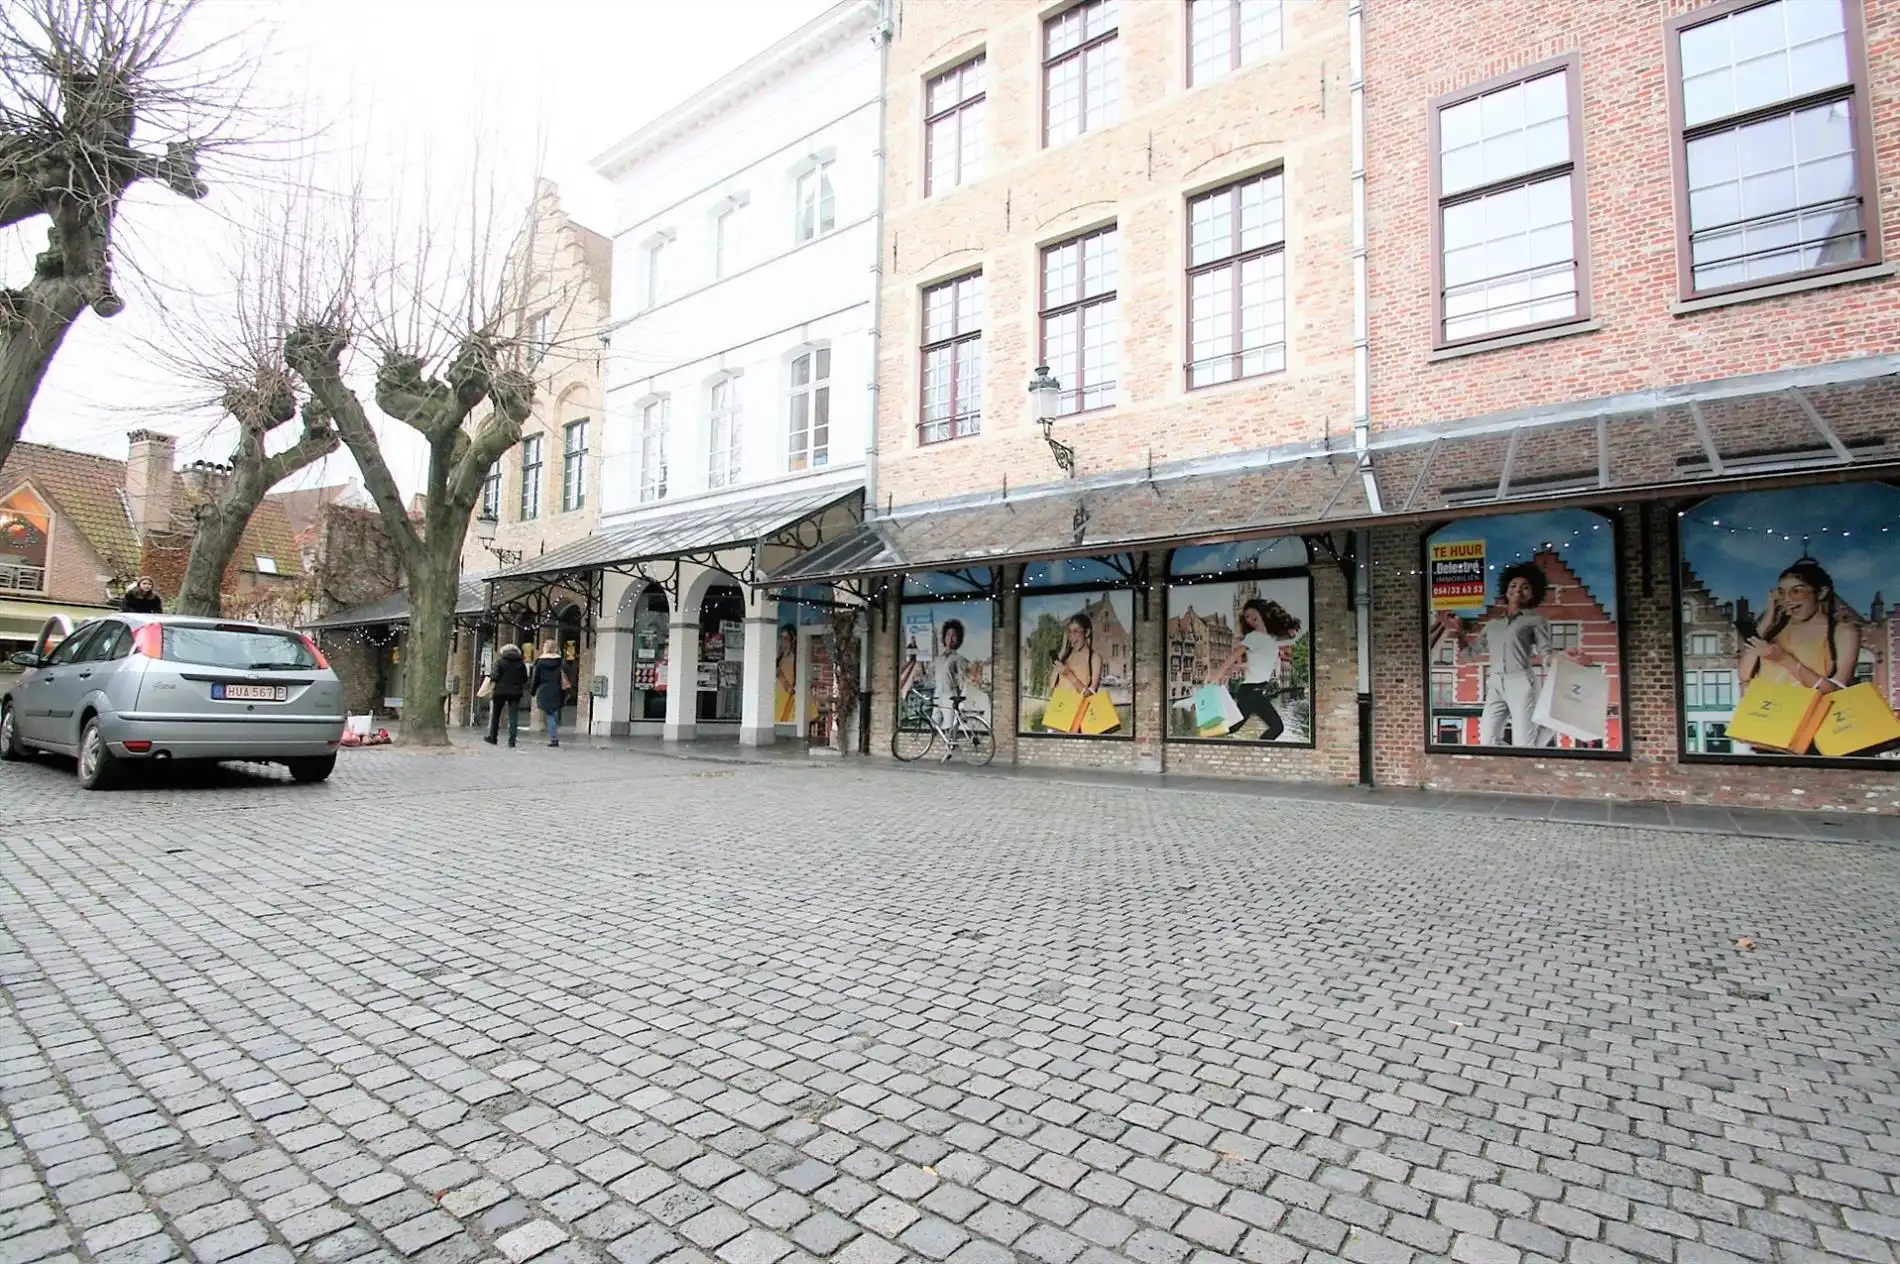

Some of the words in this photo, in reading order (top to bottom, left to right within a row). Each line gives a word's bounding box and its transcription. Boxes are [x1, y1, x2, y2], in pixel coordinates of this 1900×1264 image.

[1433, 547, 1447, 558] TE
[1450, 544, 1482, 556] HUUR
[252, 687, 273, 698] 567
